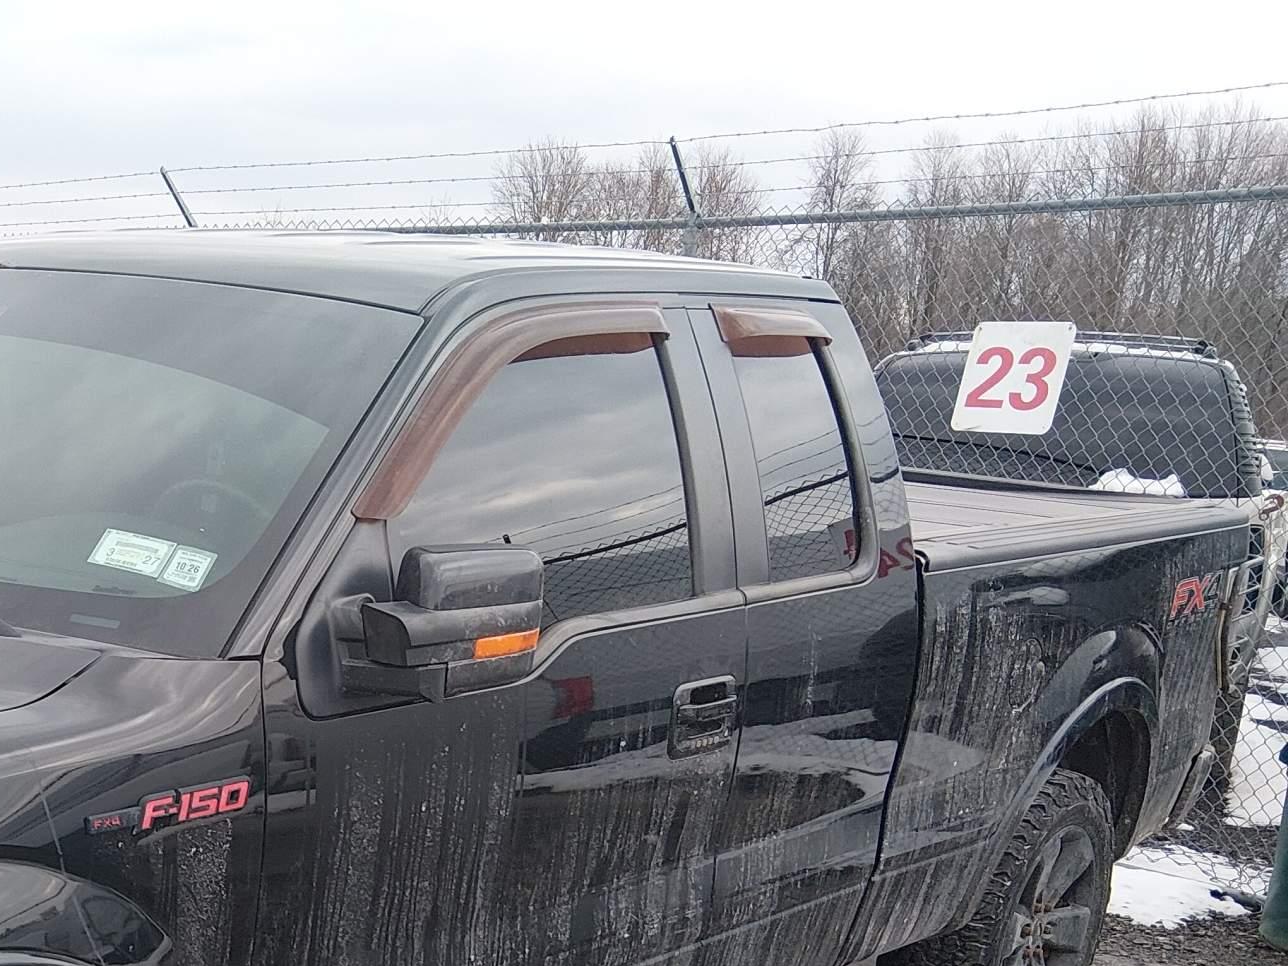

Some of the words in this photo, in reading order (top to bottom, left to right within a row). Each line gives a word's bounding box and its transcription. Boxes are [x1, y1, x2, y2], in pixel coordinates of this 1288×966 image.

[964, 346, 1057, 411] 23
[141, 555, 161, 566] 27
[1169, 569, 1224, 620] FX4
[92, 815, 121, 830] FX4
[140, 780, 250, 831] F-150
